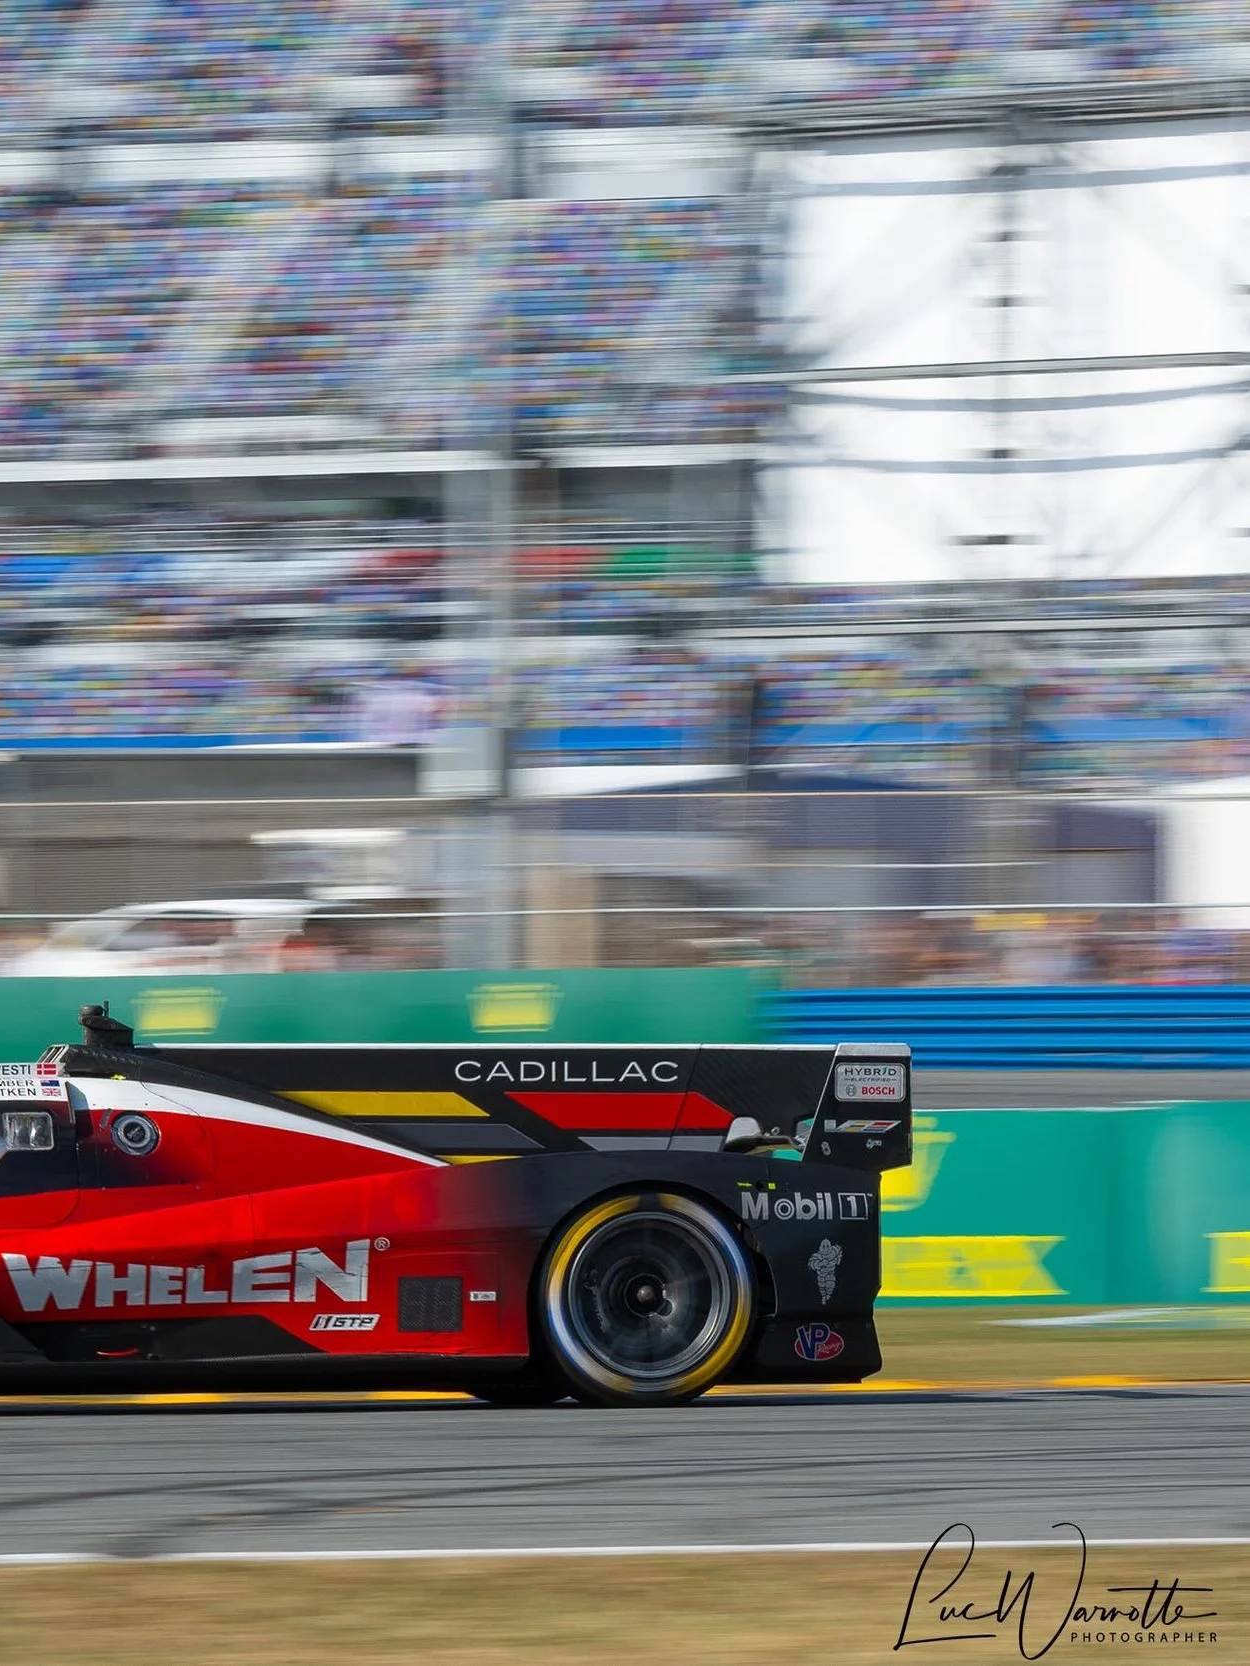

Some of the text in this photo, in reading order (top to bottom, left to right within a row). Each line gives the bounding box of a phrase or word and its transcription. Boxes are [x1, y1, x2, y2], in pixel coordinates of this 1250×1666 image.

[454, 1060, 679, 1083] CADILLAC
[844, 1067, 897, 1076] HYBRID
[861, 1086, 896, 1096] BOSCH
[741, 1191, 834, 1221] Mobil
[0, 1238, 371, 1312] WHELEN
[332, 1317, 374, 1328] GTP
[796, 1323, 830, 1360] VP
